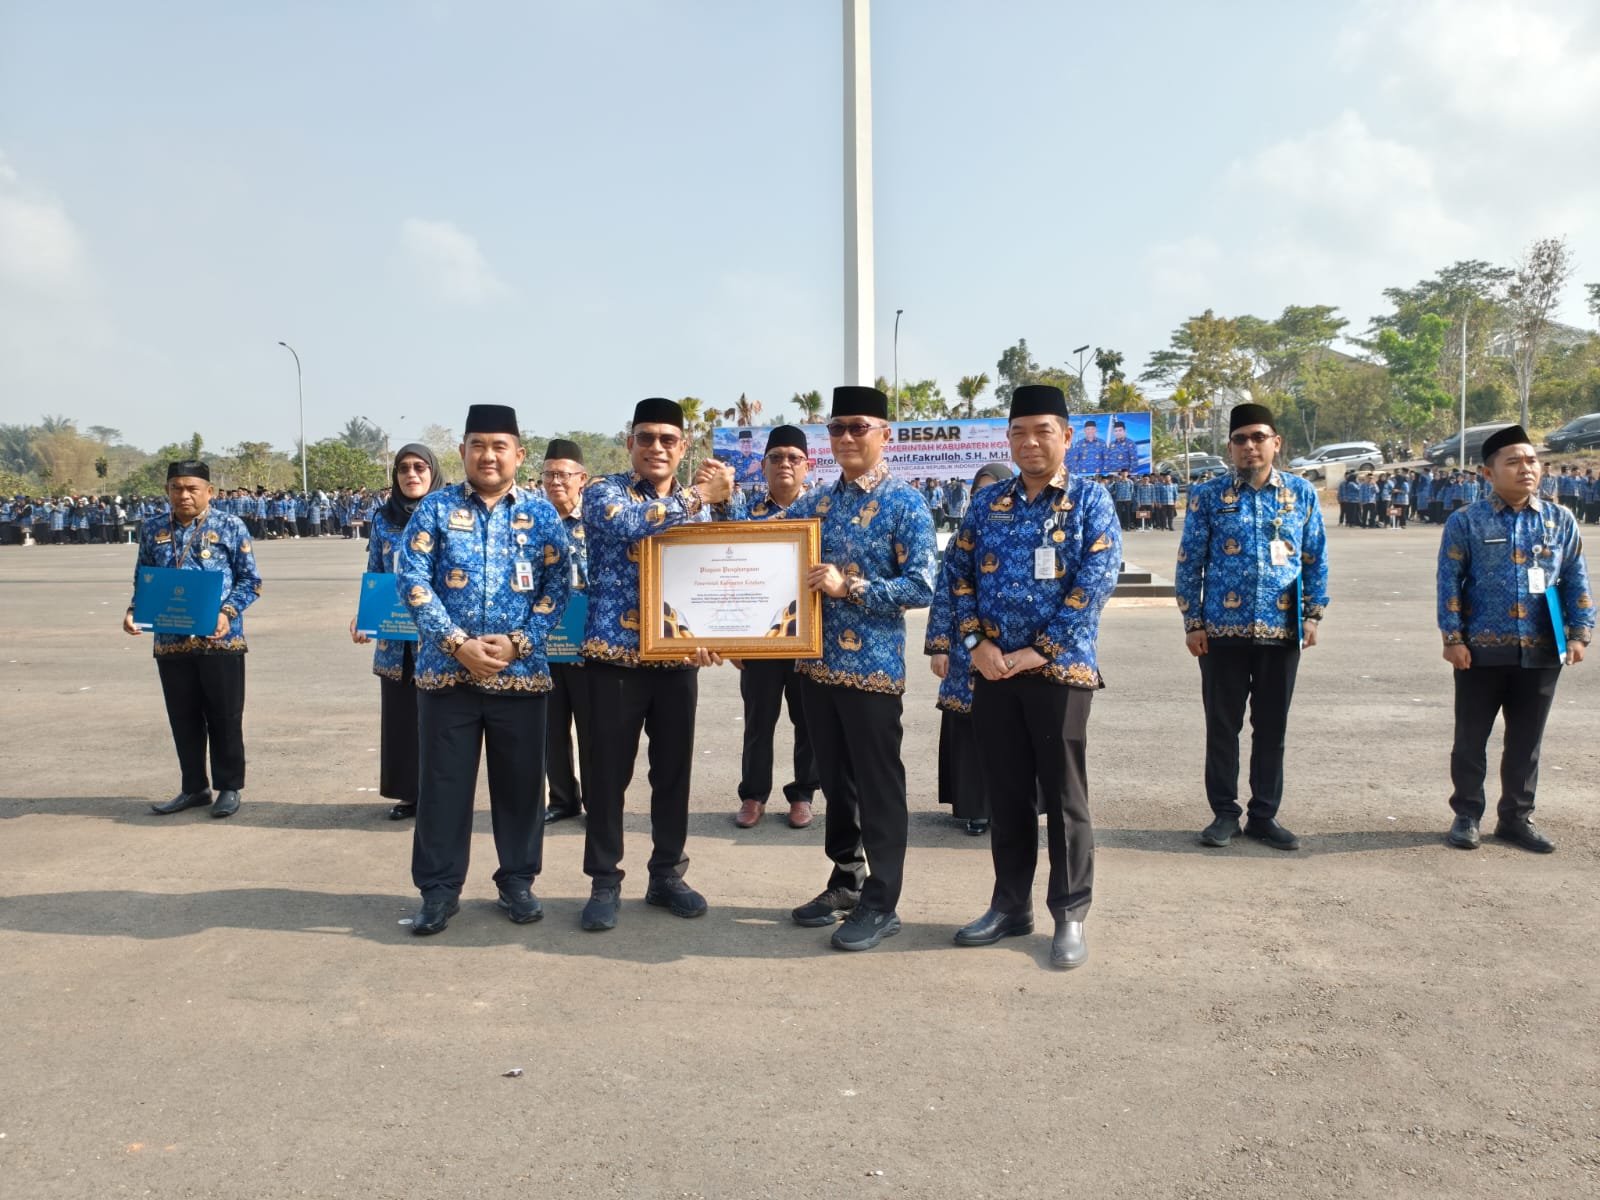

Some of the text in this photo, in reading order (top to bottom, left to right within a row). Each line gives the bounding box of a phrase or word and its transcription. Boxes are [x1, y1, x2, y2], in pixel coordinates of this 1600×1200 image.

[898, 426, 960, 443] BESAR
[883, 444, 933, 453] EMERINTAH
[936, 441, 988, 451] KABUPATEN
[990, 440, 1010, 448] KOT
